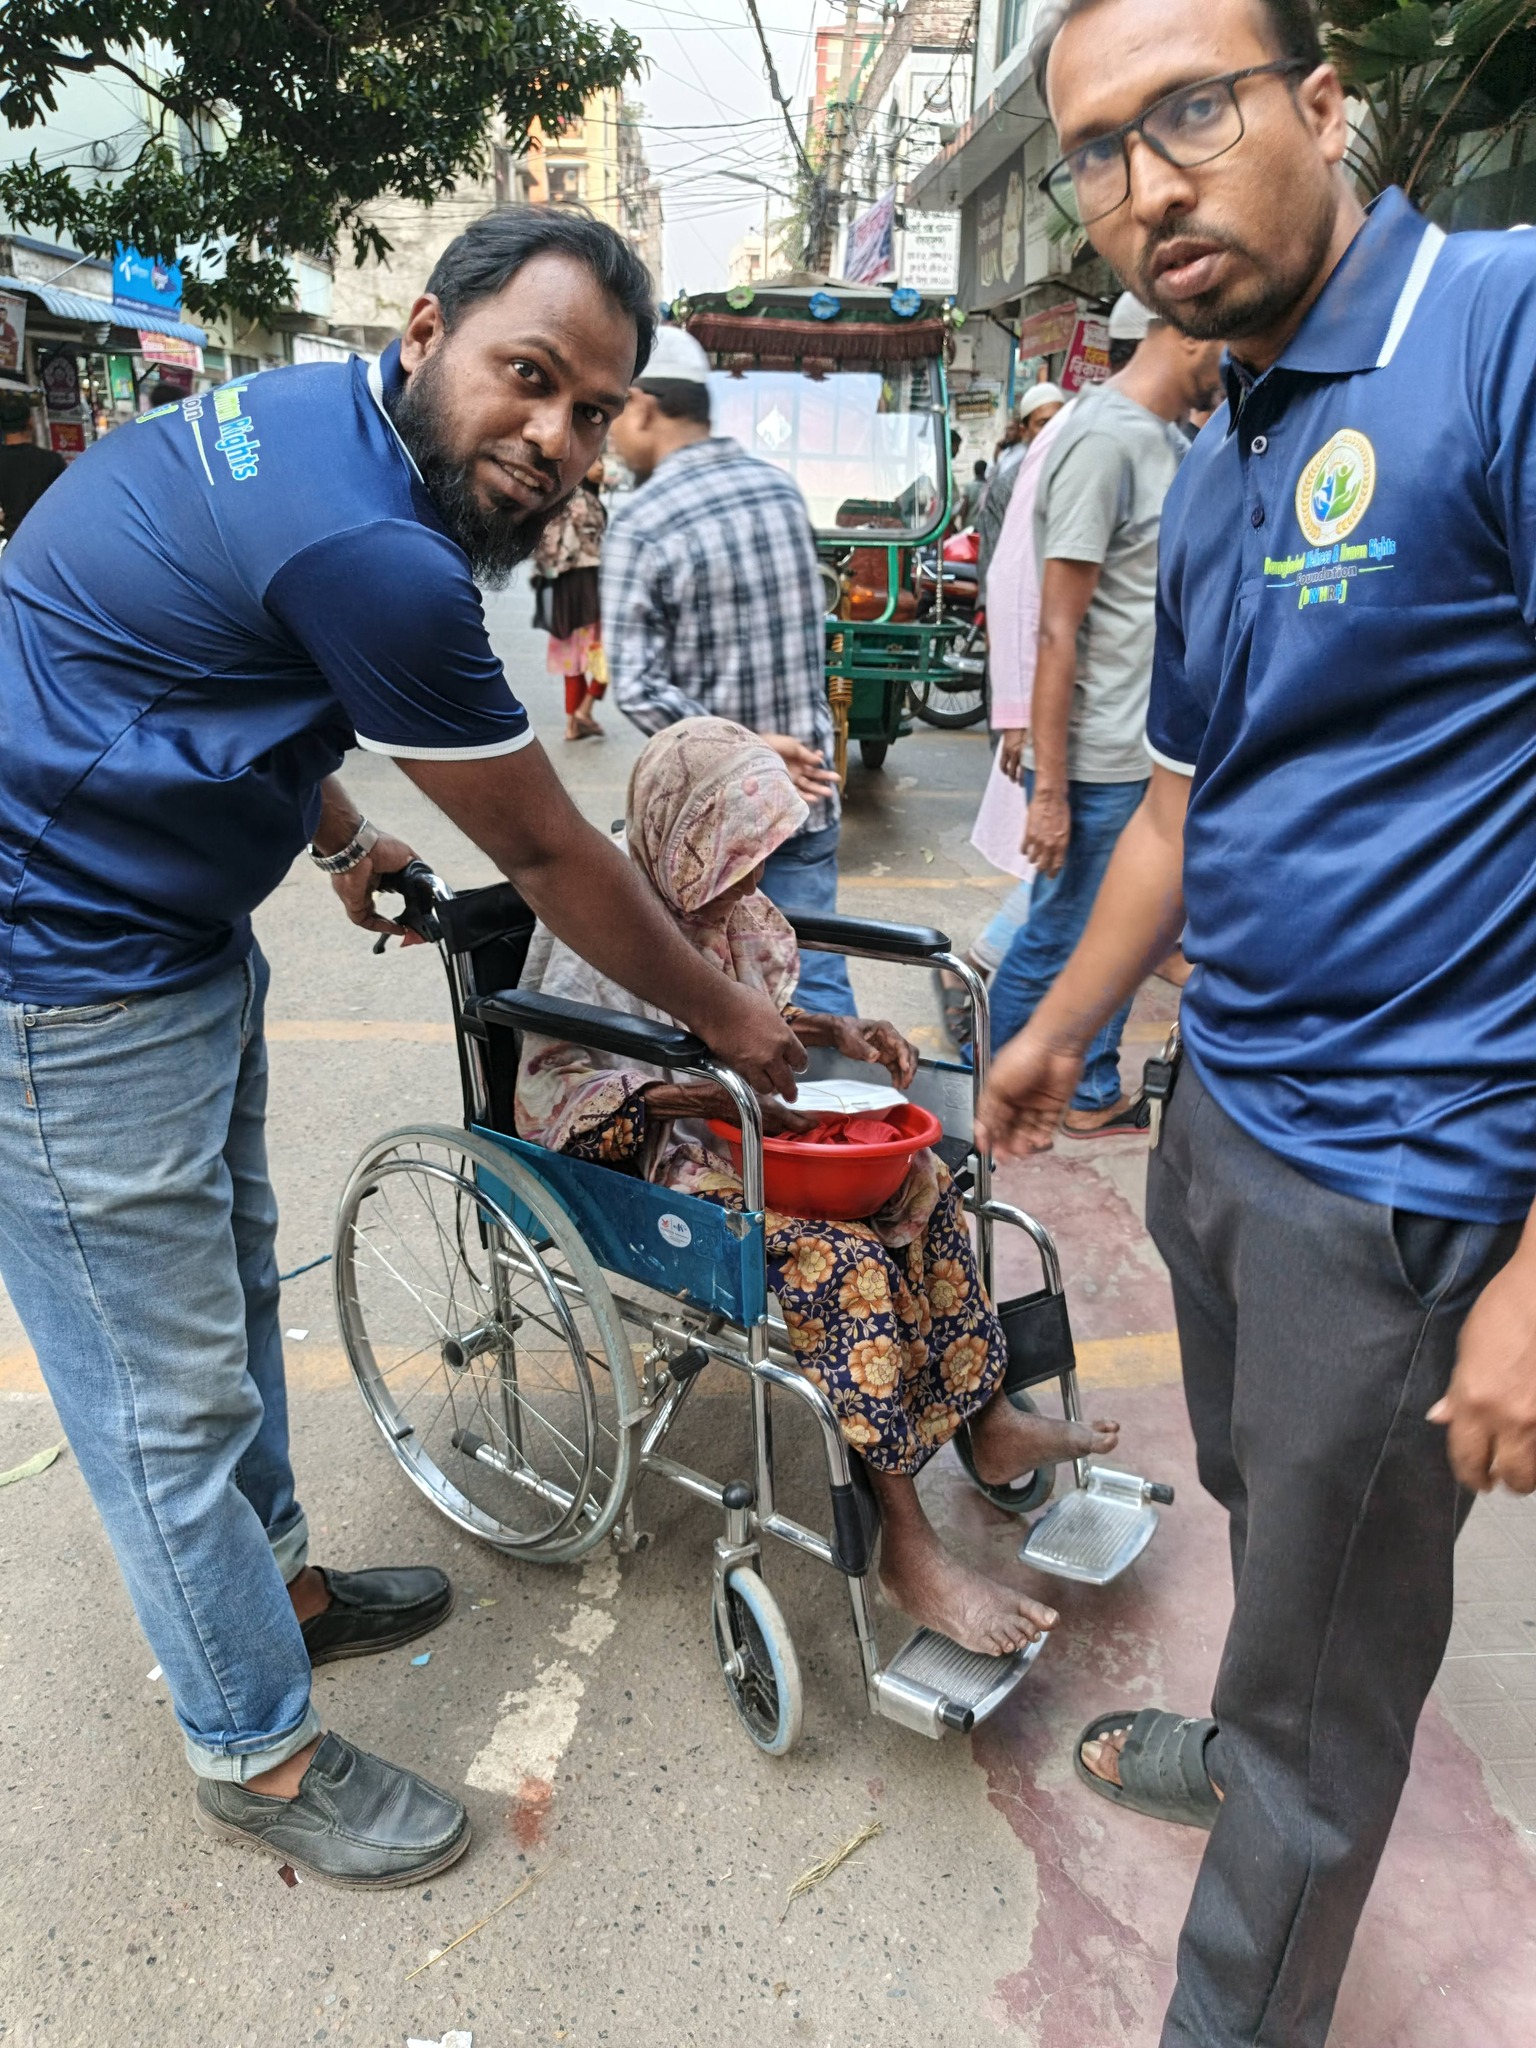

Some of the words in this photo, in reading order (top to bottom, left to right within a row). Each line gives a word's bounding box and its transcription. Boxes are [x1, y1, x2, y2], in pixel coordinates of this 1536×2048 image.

[215, 416, 261, 481] Rights
[1368, 536, 1396, 561] Rights
[1295, 564, 1357, 586] Foundation
